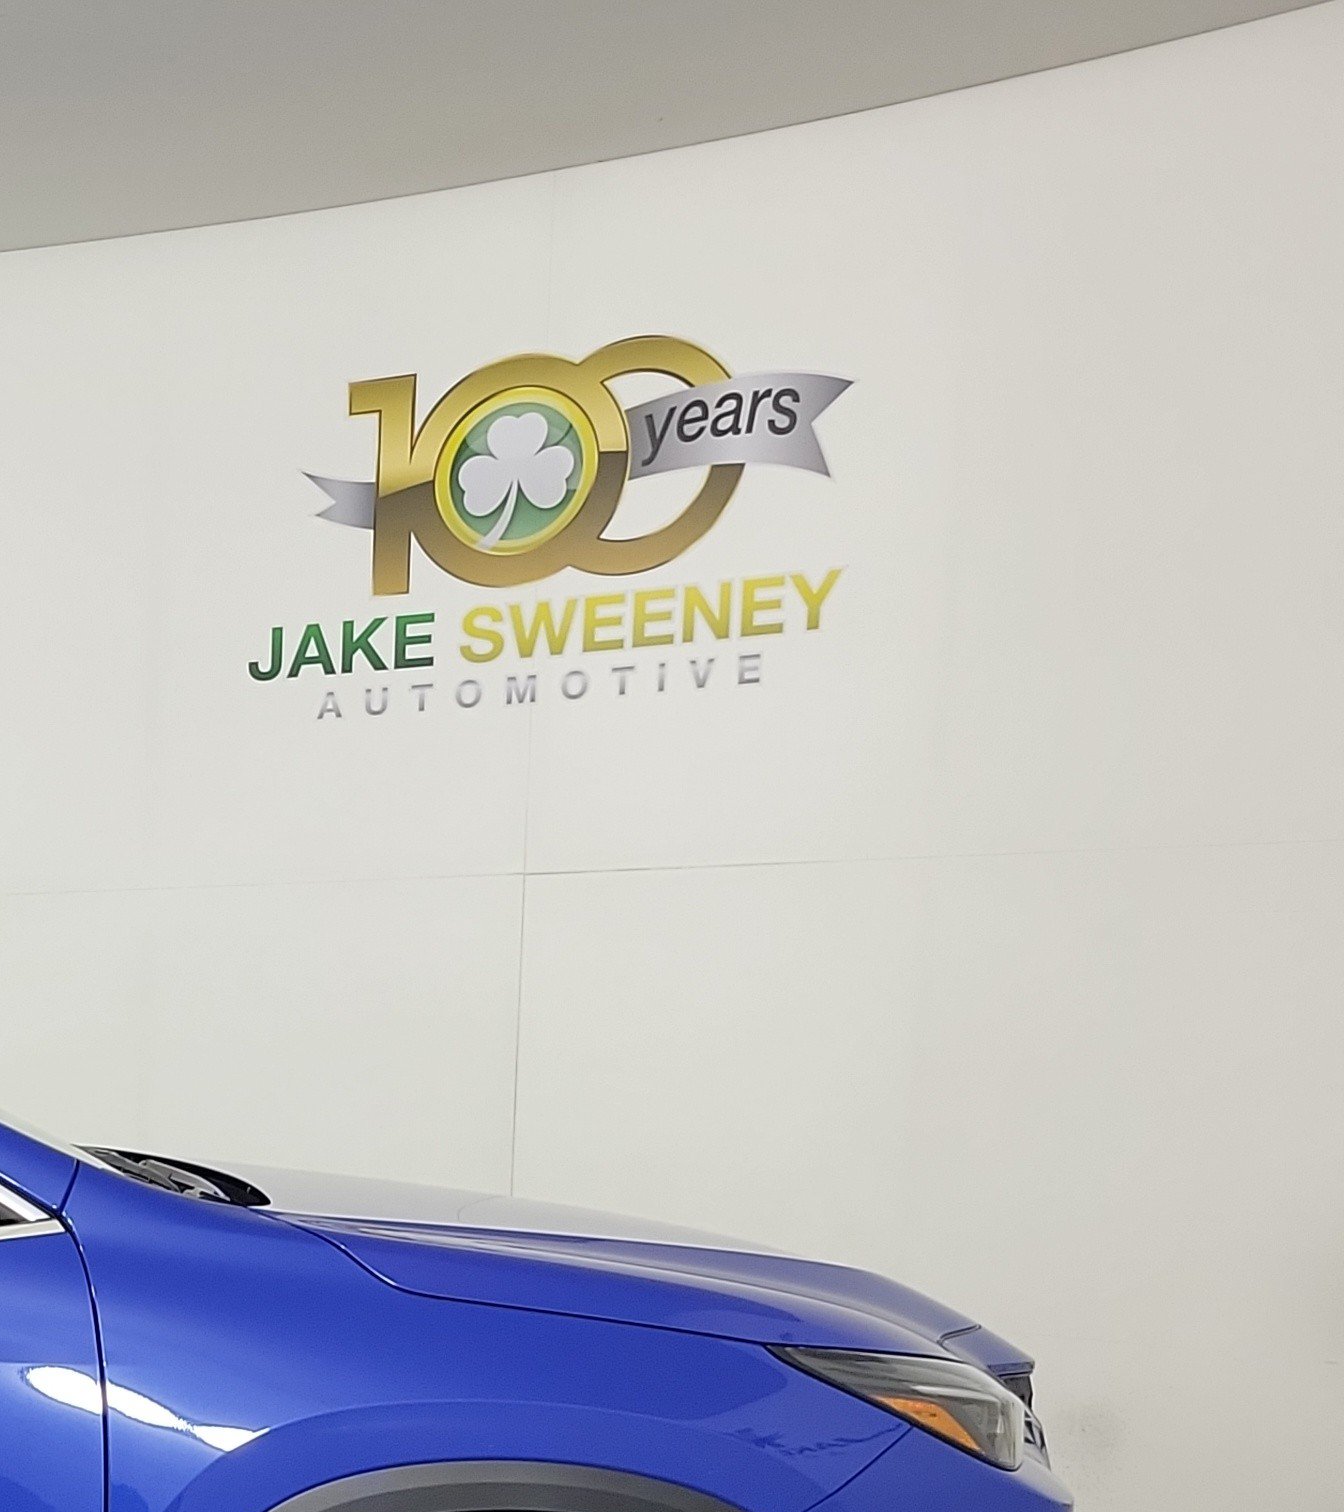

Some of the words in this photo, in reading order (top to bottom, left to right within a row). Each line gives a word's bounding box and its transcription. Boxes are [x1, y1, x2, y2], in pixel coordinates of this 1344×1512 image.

[640, 386, 802, 467] years
[248, 612, 436, 682] JAKE
[459, 568, 845, 664] SWEENEY
[316, 654, 762, 720] AUTOMOTIVE
